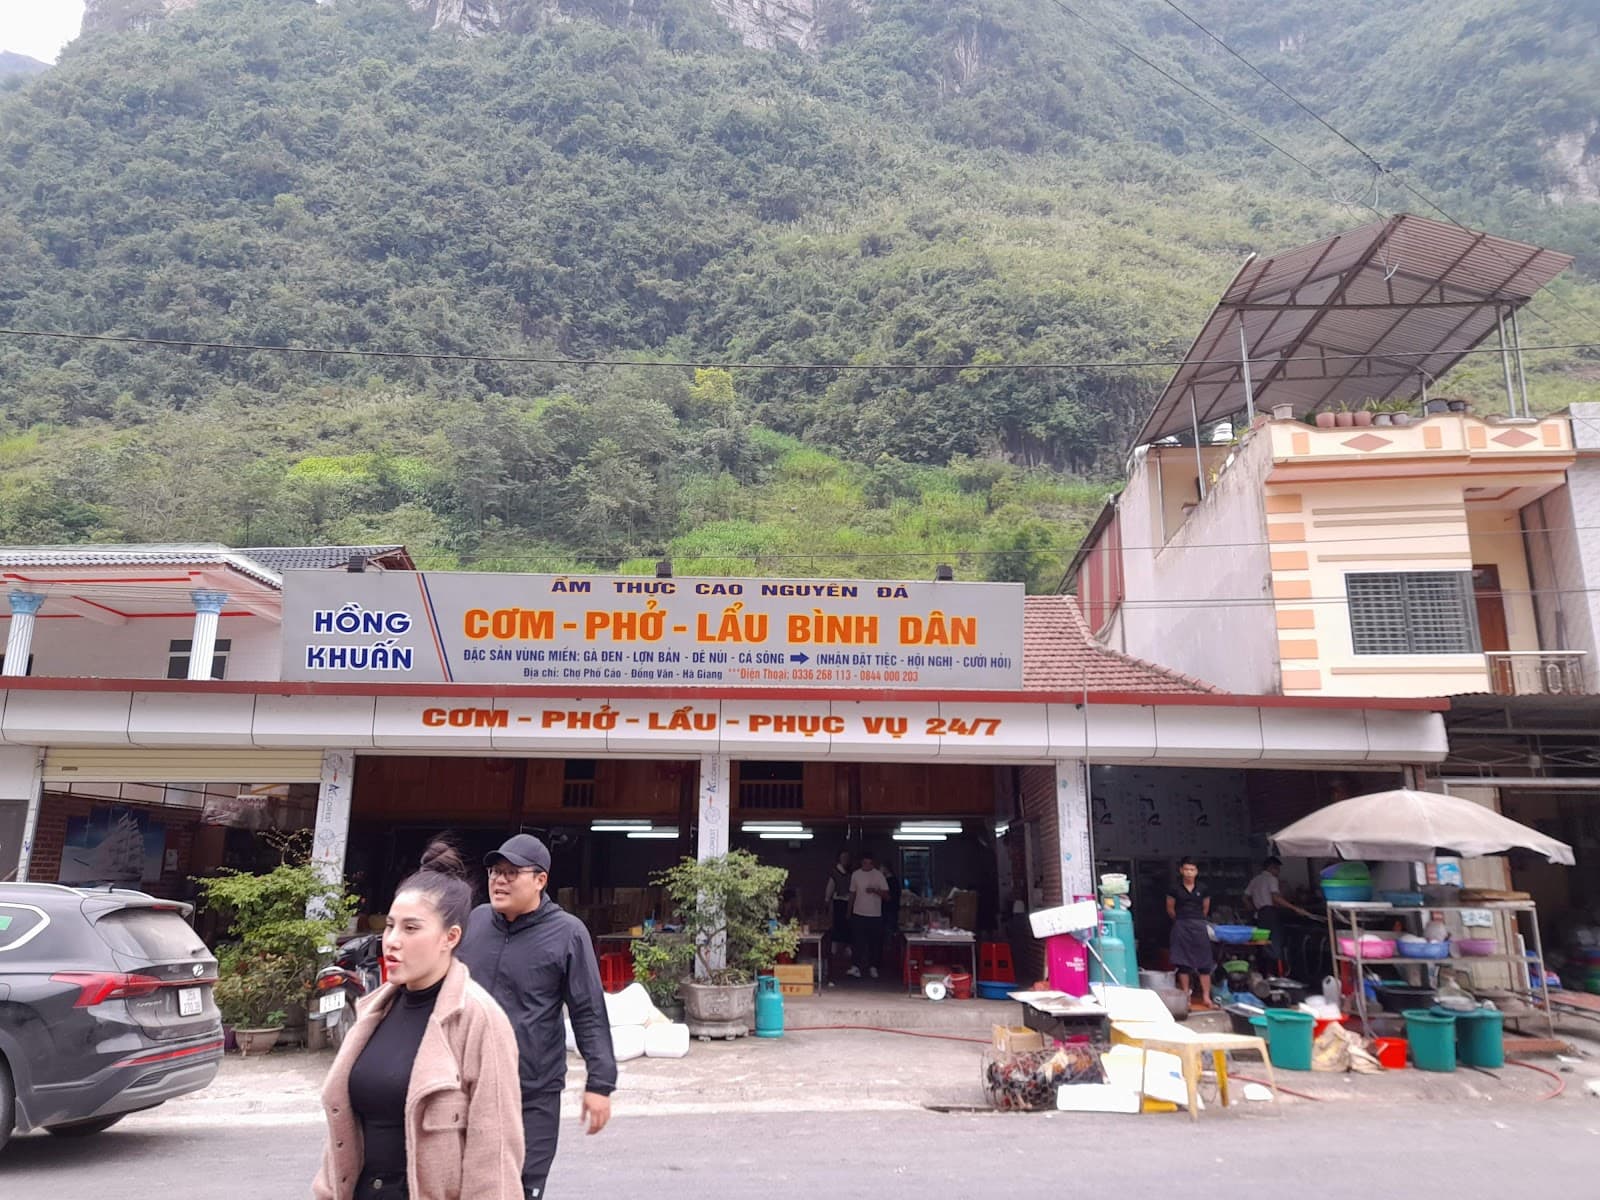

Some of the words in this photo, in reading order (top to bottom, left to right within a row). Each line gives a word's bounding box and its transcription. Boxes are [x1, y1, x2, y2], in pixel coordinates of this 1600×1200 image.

[613, 581, 676, 597] THỰC
[695, 583, 744, 595] CAO
[761, 583, 858, 598] NGUYÊN
[877, 584, 909, 598] ĐÁ
[314, 602, 411, 634] HỒNG
[464, 607, 555, 641] CƠM
[585, 600, 667, 642] PHỞ
[696, 602, 768, 643] LẨU
[787, 609, 879, 644] BÌNH
[899, 610, 977, 646] DÂN
[306, 639, 413, 670] KHUẤN
[463, 647, 485, 664] ĐẶC
[489, 645, 512, 661] SẢN
[601, 650, 623, 662] ĐEN
[633, 651, 653, 665] LỢN
[756, 649, 785, 665] SÔNG
[875, 651, 897, 668] TIỆC
[907, 652, 924, 669] HỘI
[928, 656, 953, 671] NGHỊ
[523, 667, 539, 680] Địa
[563, 667, 580, 680] Chợ
[697, 668, 722, 680] Giang
[792, 669, 814, 680] 0336
[816, 669, 832, 680] 268
[836, 670, 851, 681] 113
[860, 670, 881, 681] 0844
[884, 671, 899, 682] 000
[902, 671, 918, 682] 203
[422, 707, 509, 728] CƠM
[541, 704, 620, 730] PHỞ
[648, 705, 717, 731] LẨU
[749, 714, 845, 737] PHỤC
[862, 716, 908, 738] VỤ
[925, 717, 1002, 736] 24/7
